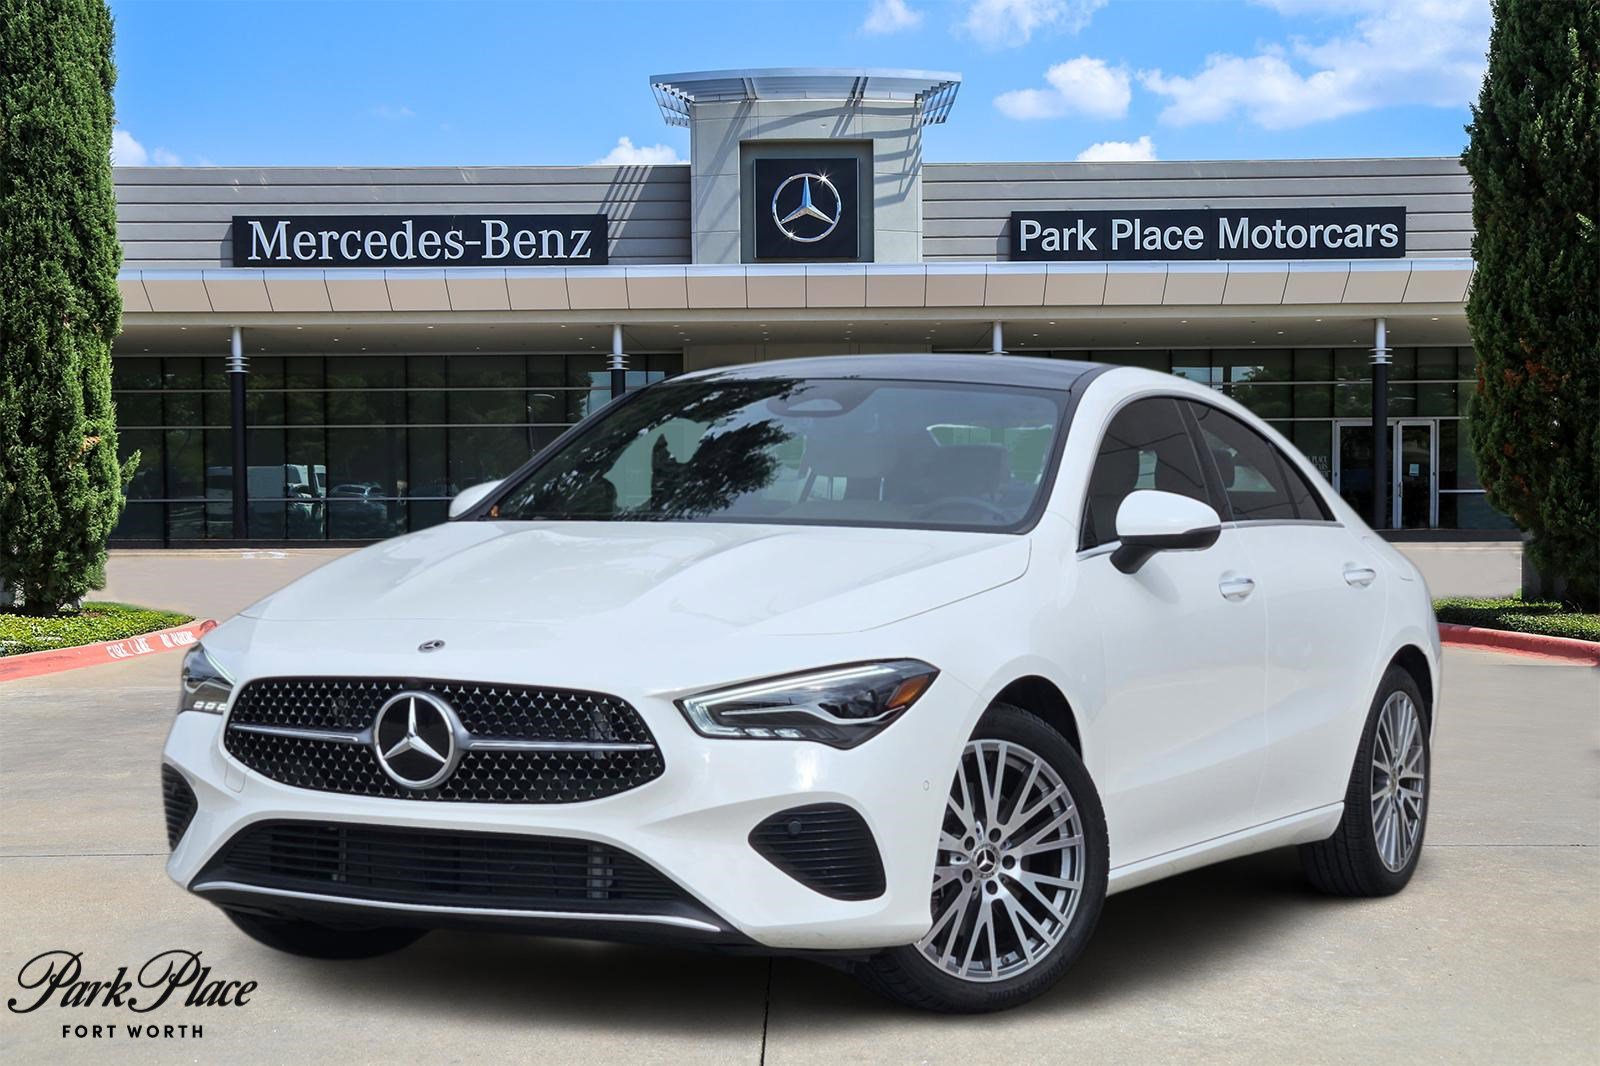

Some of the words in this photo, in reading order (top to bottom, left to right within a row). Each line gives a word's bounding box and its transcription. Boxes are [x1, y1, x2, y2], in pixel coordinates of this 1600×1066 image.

[248, 219, 592, 260] Mercedes-Benz
[1019, 218, 1098, 252] Park
[1111, 218, 1205, 250] Place
[1217, 216, 1399, 249] Motorcars
[105, 642, 135, 660] FIRE
[128, 637, 155, 655] LANE
